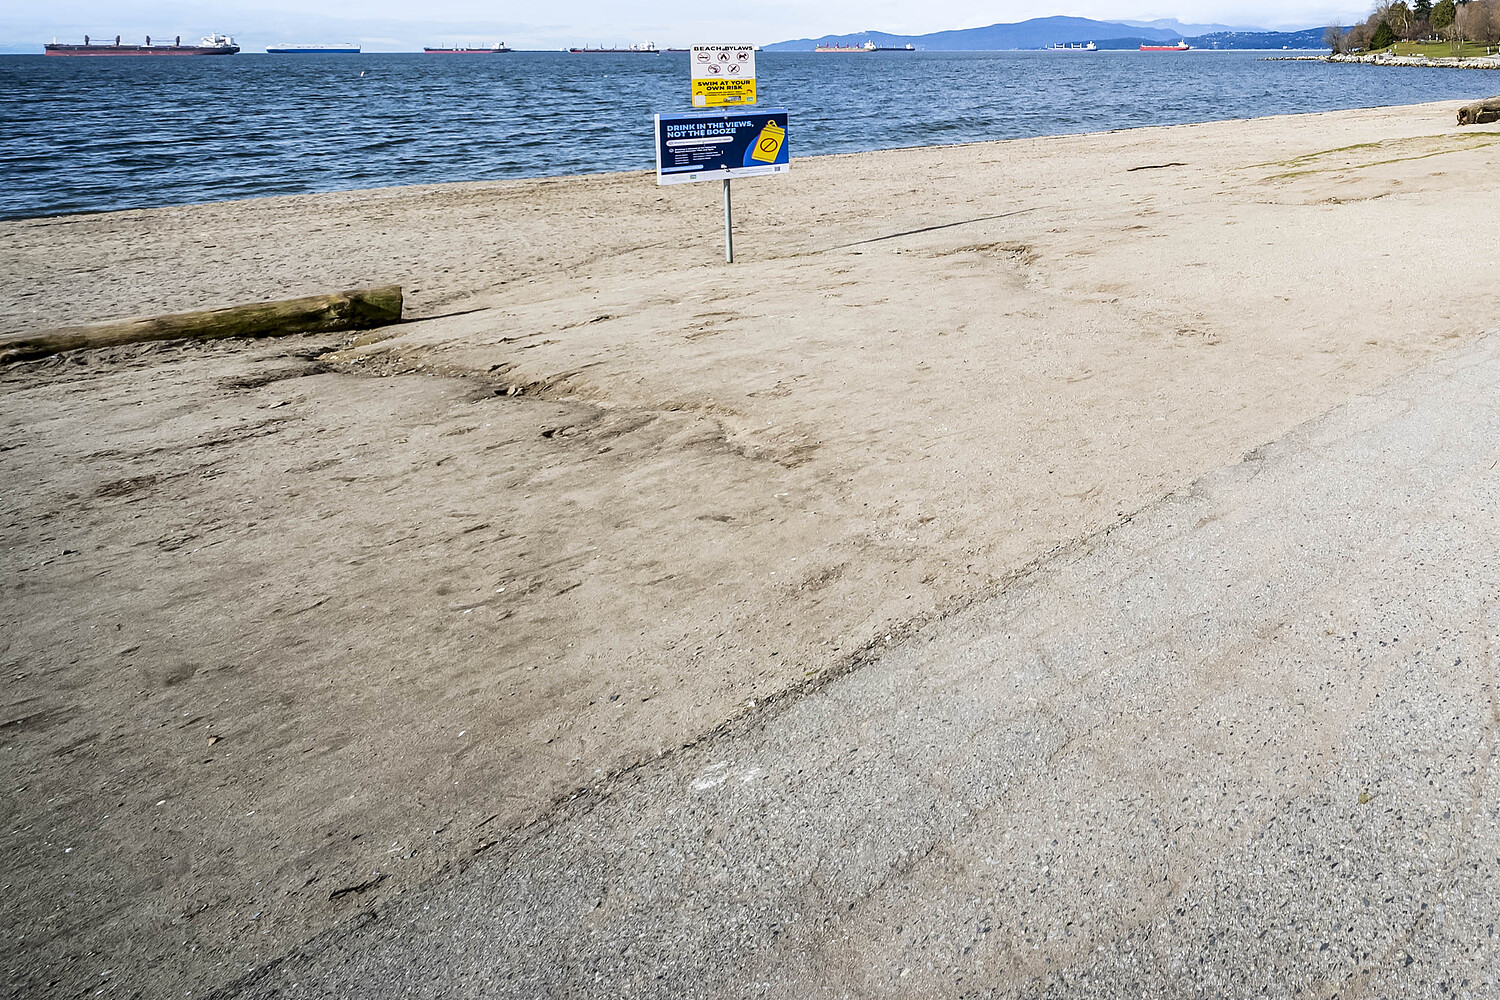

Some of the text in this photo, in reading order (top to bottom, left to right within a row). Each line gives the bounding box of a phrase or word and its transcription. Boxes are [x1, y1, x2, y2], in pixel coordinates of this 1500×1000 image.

[666, 123, 696, 132] DRINK
[725, 120, 755, 128] VIEWS,
[706, 128, 737, 136] BOOZE
